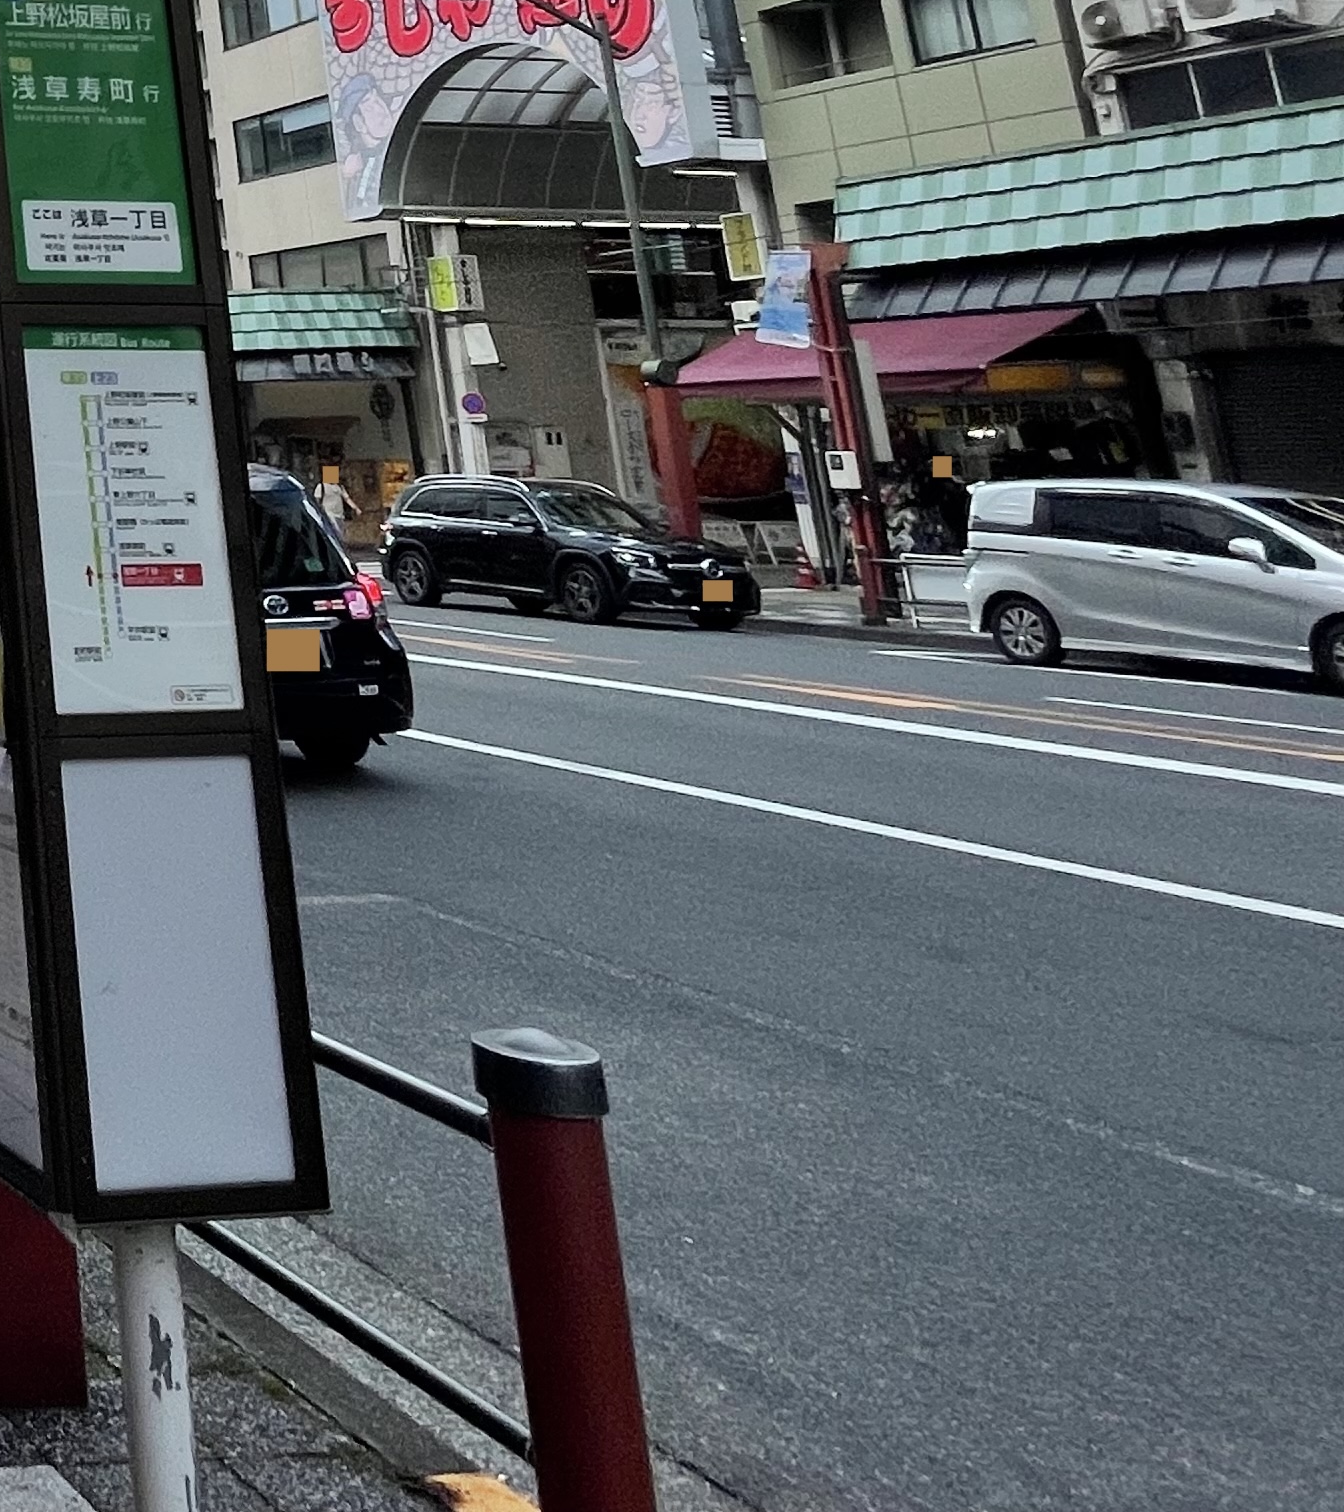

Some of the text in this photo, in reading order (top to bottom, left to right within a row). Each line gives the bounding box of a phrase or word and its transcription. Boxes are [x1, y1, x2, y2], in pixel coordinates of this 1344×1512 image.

[70, 209, 167, 230] 浅草一丁目
